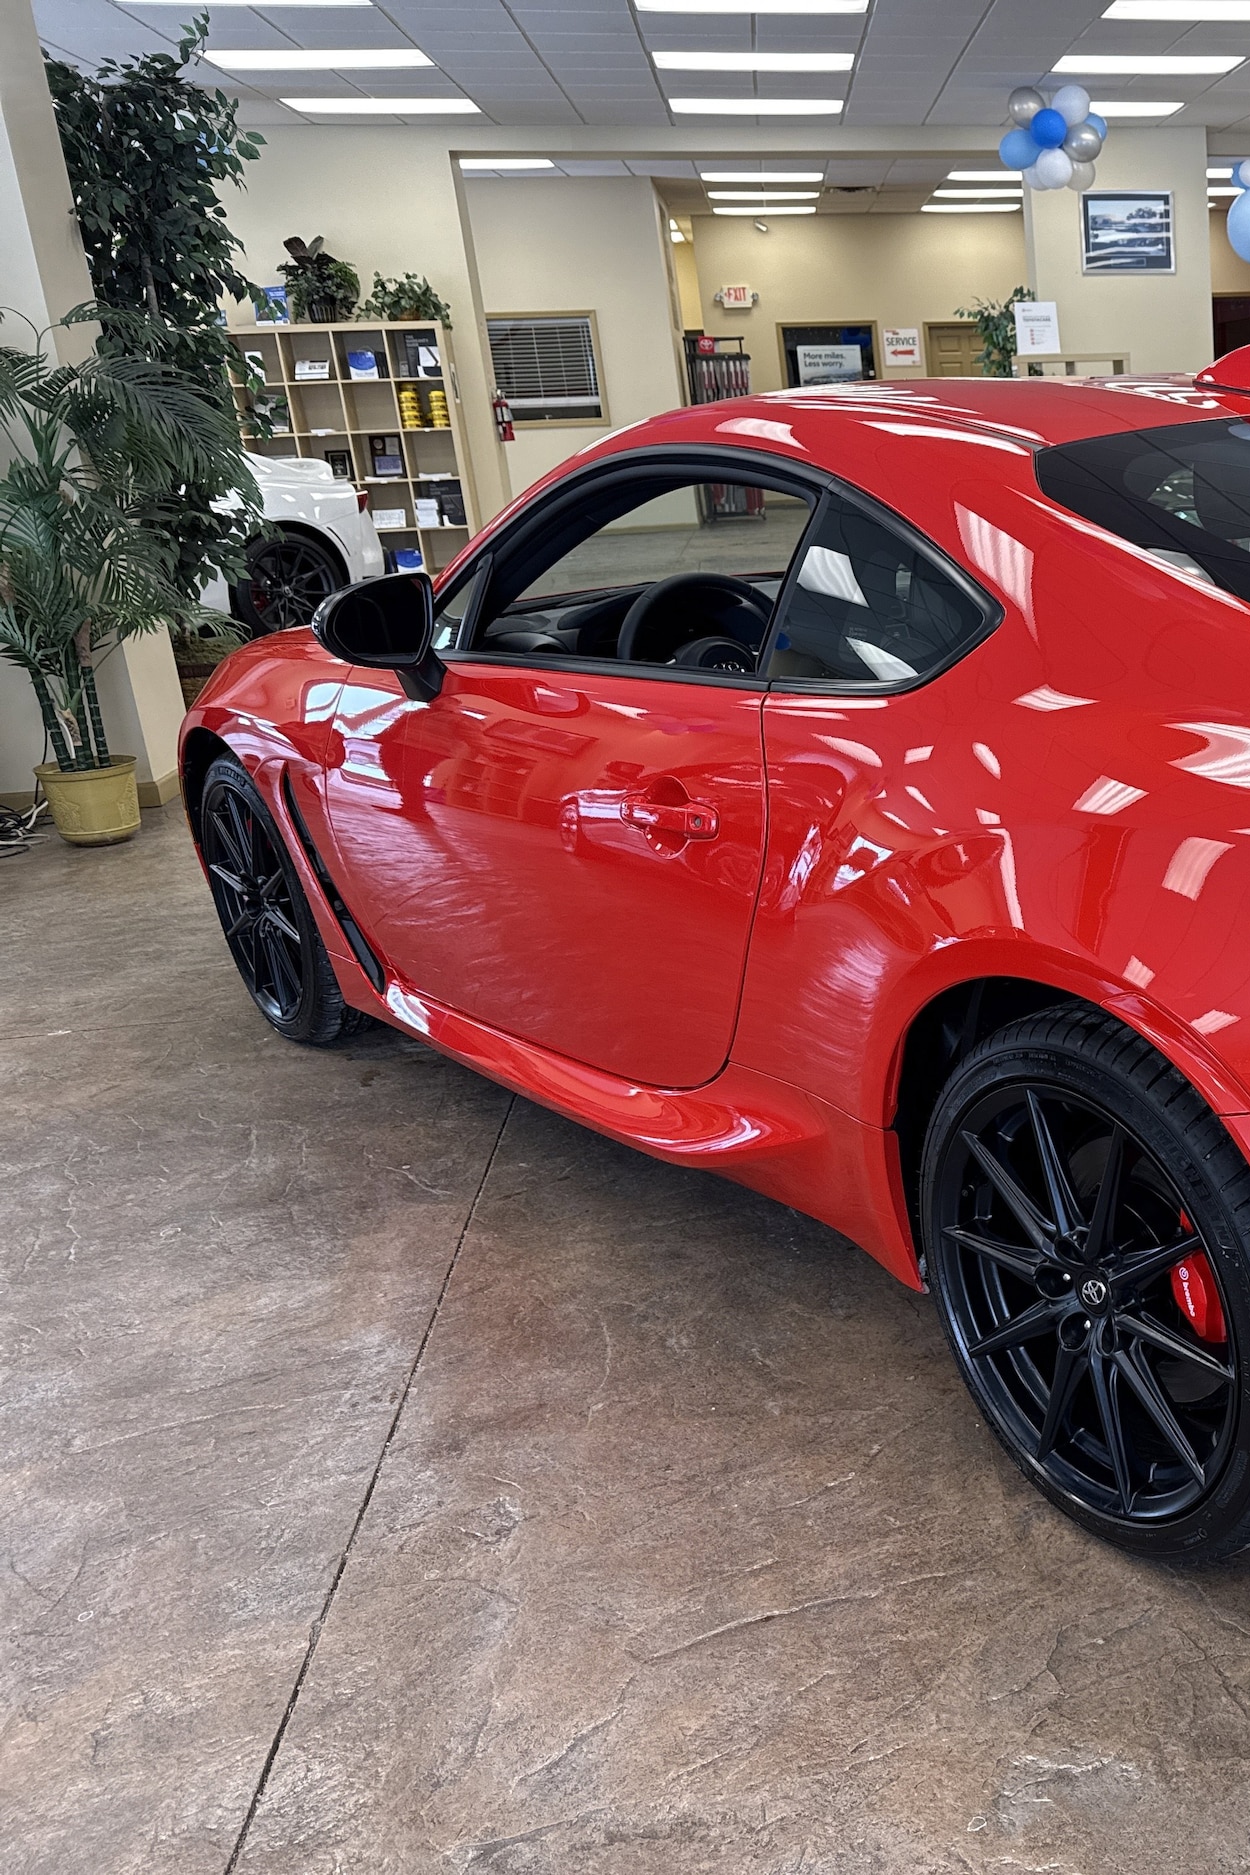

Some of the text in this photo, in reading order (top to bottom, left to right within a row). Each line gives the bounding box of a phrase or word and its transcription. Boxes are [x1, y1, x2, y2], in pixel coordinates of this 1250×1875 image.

[727, 287, 747, 301] EXIT
[886, 336, 917, 346] SERVICE
[803, 351, 846, 360] More miles.
[821, 361, 845, 369] worry.
[1182, 1281, 1196, 1317] brembo
